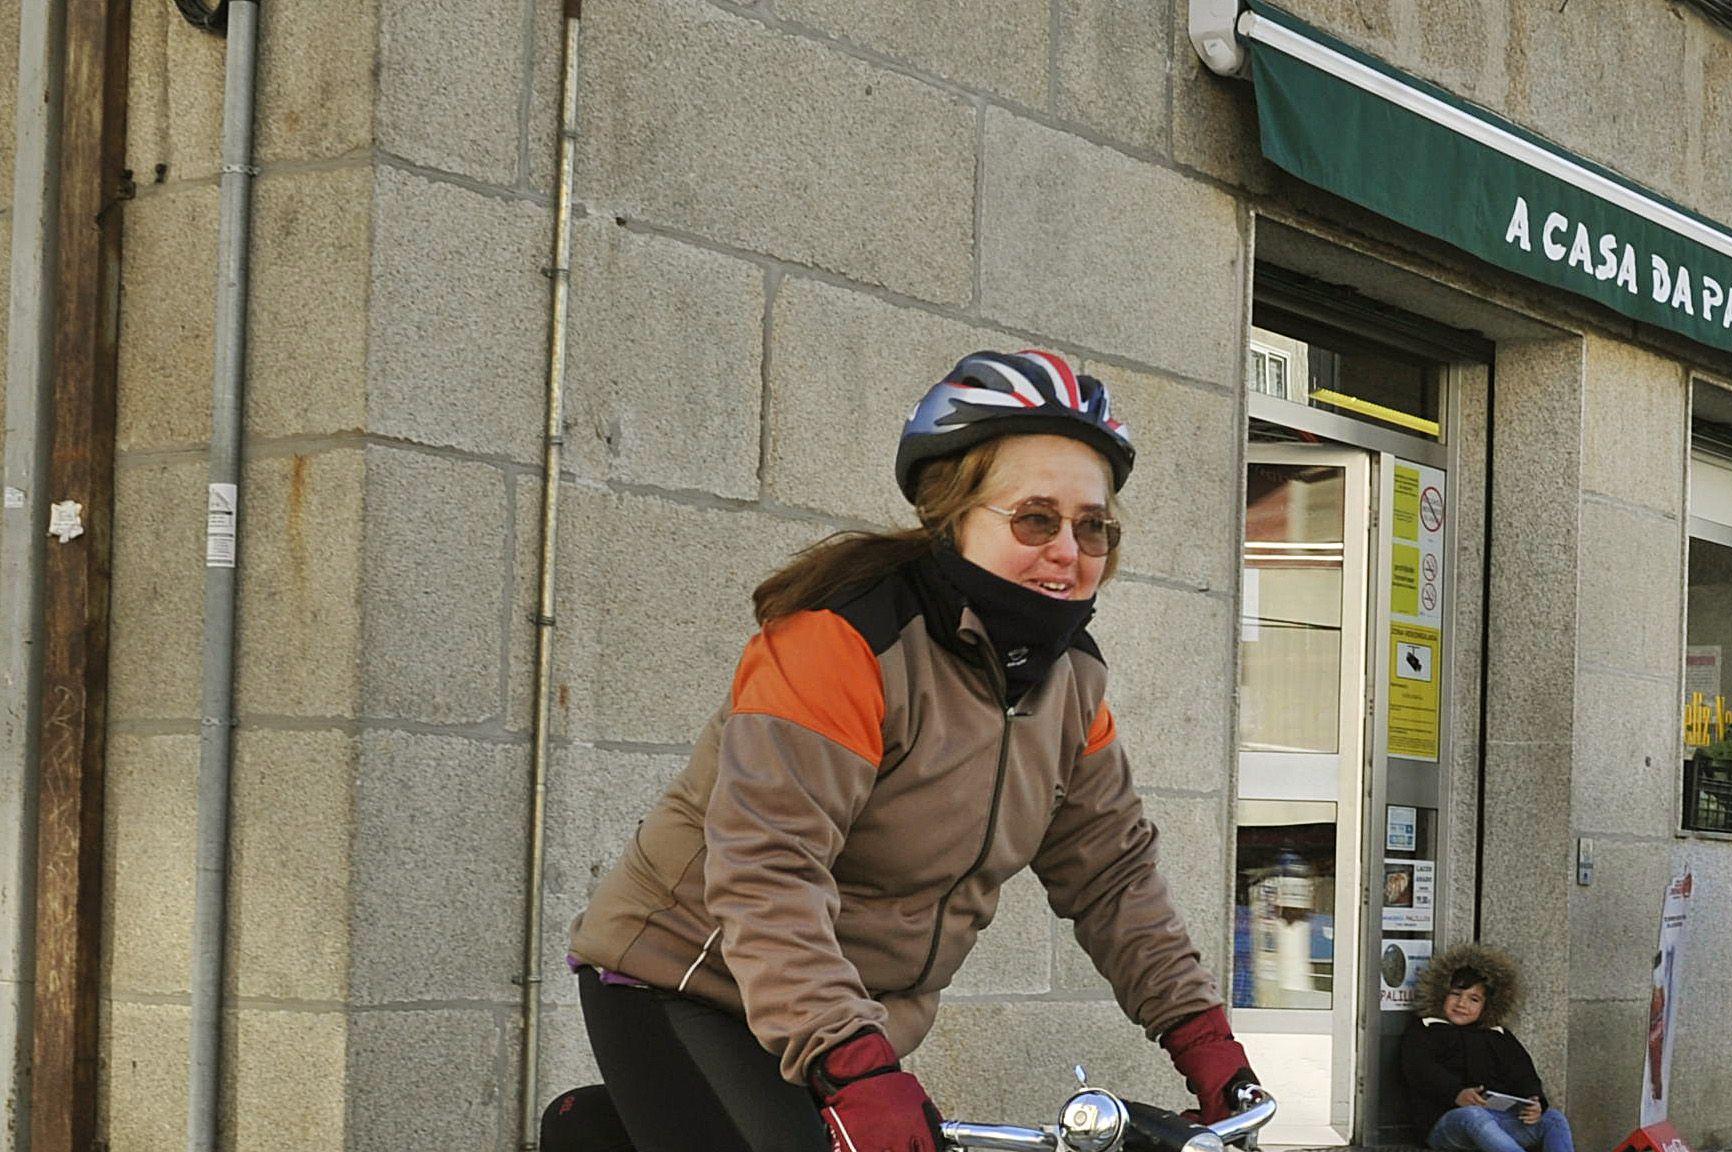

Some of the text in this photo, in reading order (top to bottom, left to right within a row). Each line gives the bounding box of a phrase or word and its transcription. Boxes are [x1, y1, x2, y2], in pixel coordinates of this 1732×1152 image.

[1505, 196, 1531, 252] A
[1542, 211, 1638, 294] CASA
[1651, 253, 1694, 316] DA
